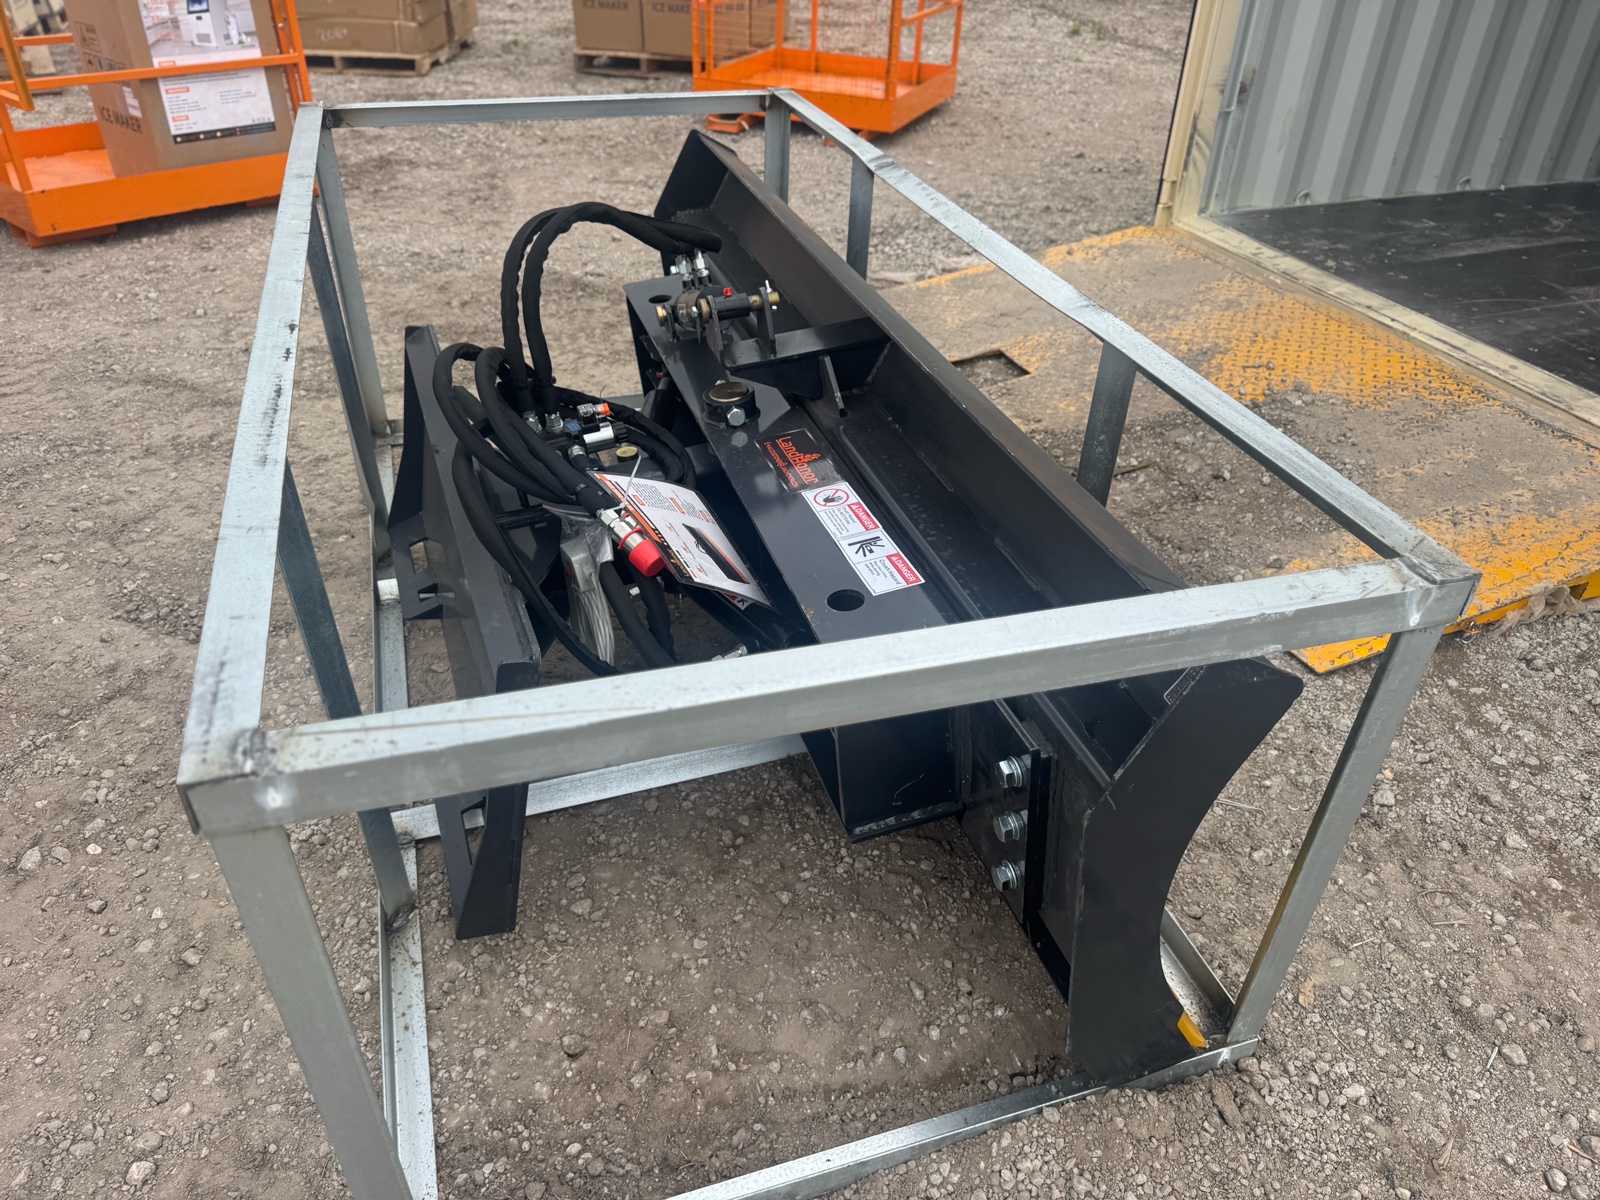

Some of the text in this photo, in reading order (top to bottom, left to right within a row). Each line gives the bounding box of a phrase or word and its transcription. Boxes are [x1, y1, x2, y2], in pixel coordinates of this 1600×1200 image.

[98, 105, 143, 135] ICE MAKER
[777, 435, 820, 483] LandHonor
[854, 508, 875, 529] DANGER
[894, 559, 916, 581] DANGER
